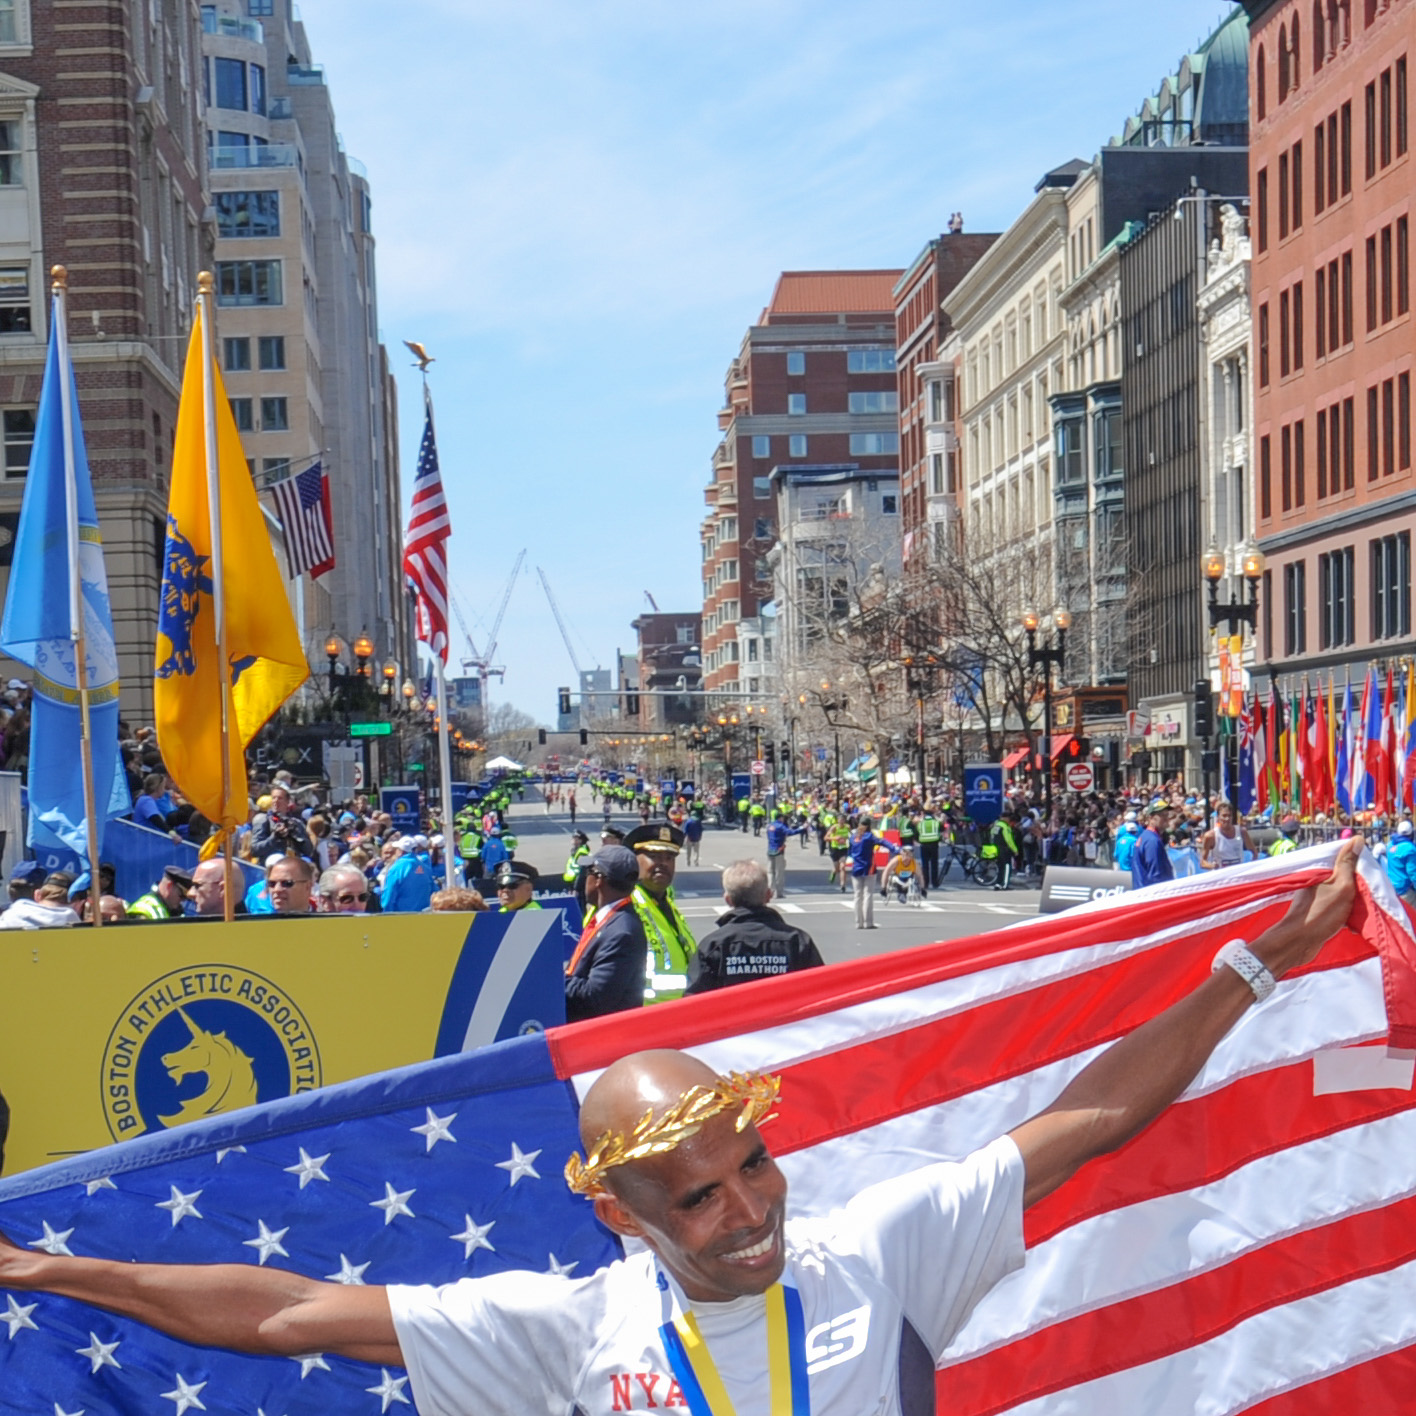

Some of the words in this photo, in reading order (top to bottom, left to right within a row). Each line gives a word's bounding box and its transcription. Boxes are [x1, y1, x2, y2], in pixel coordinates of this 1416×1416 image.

[725, 956, 747, 967] 2014
[749, 955, 787, 965] BOSTON
[725, 964, 788, 975] MARATHON
[109, 1035, 138, 1133] BOSTON
[127, 972, 233, 1035] ATHLETIC
[236, 977, 316, 1096] ASSOCIATI
